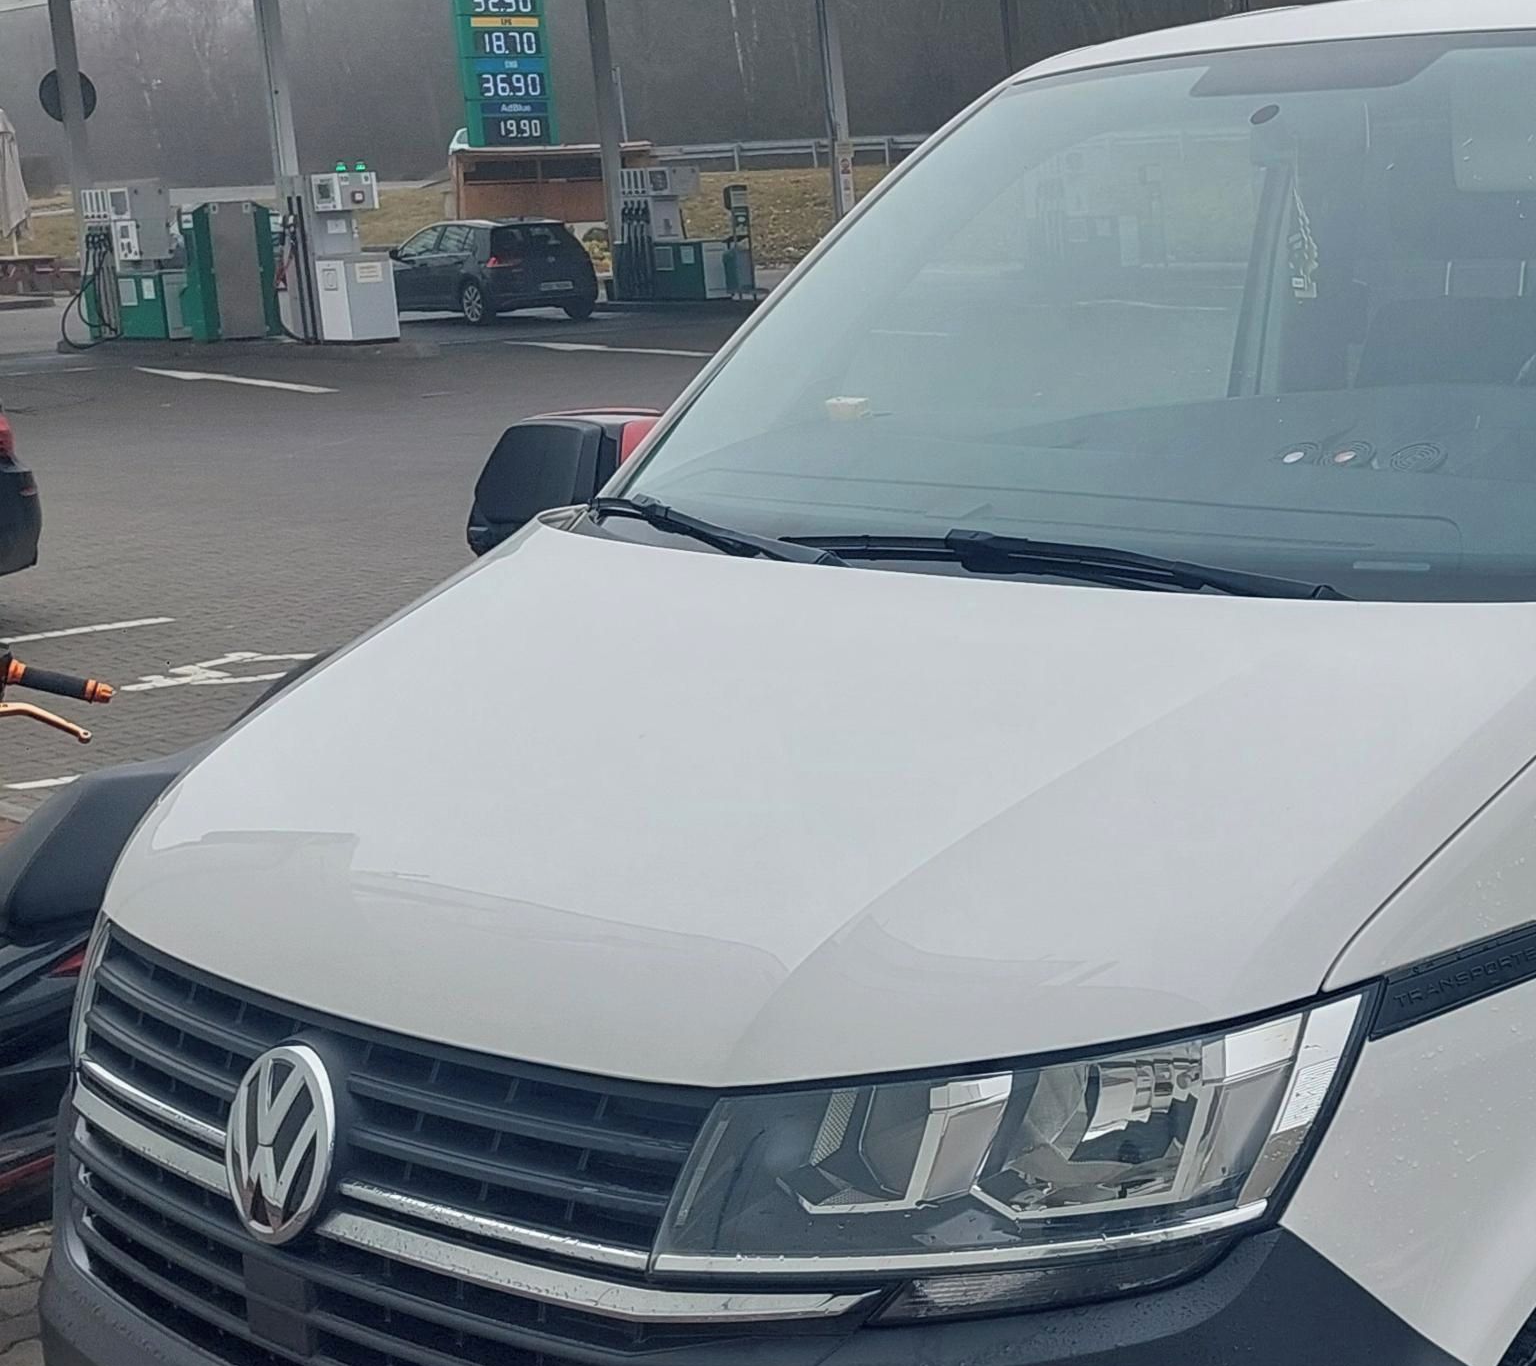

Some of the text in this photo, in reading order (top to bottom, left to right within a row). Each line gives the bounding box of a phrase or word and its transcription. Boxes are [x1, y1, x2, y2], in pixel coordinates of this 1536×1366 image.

[484, 31, 537, 54] 18.70
[481, 74, 541, 97] 36.90
[500, 103, 532, 113] AdBlue
[500, 119, 542, 138] 19.90
